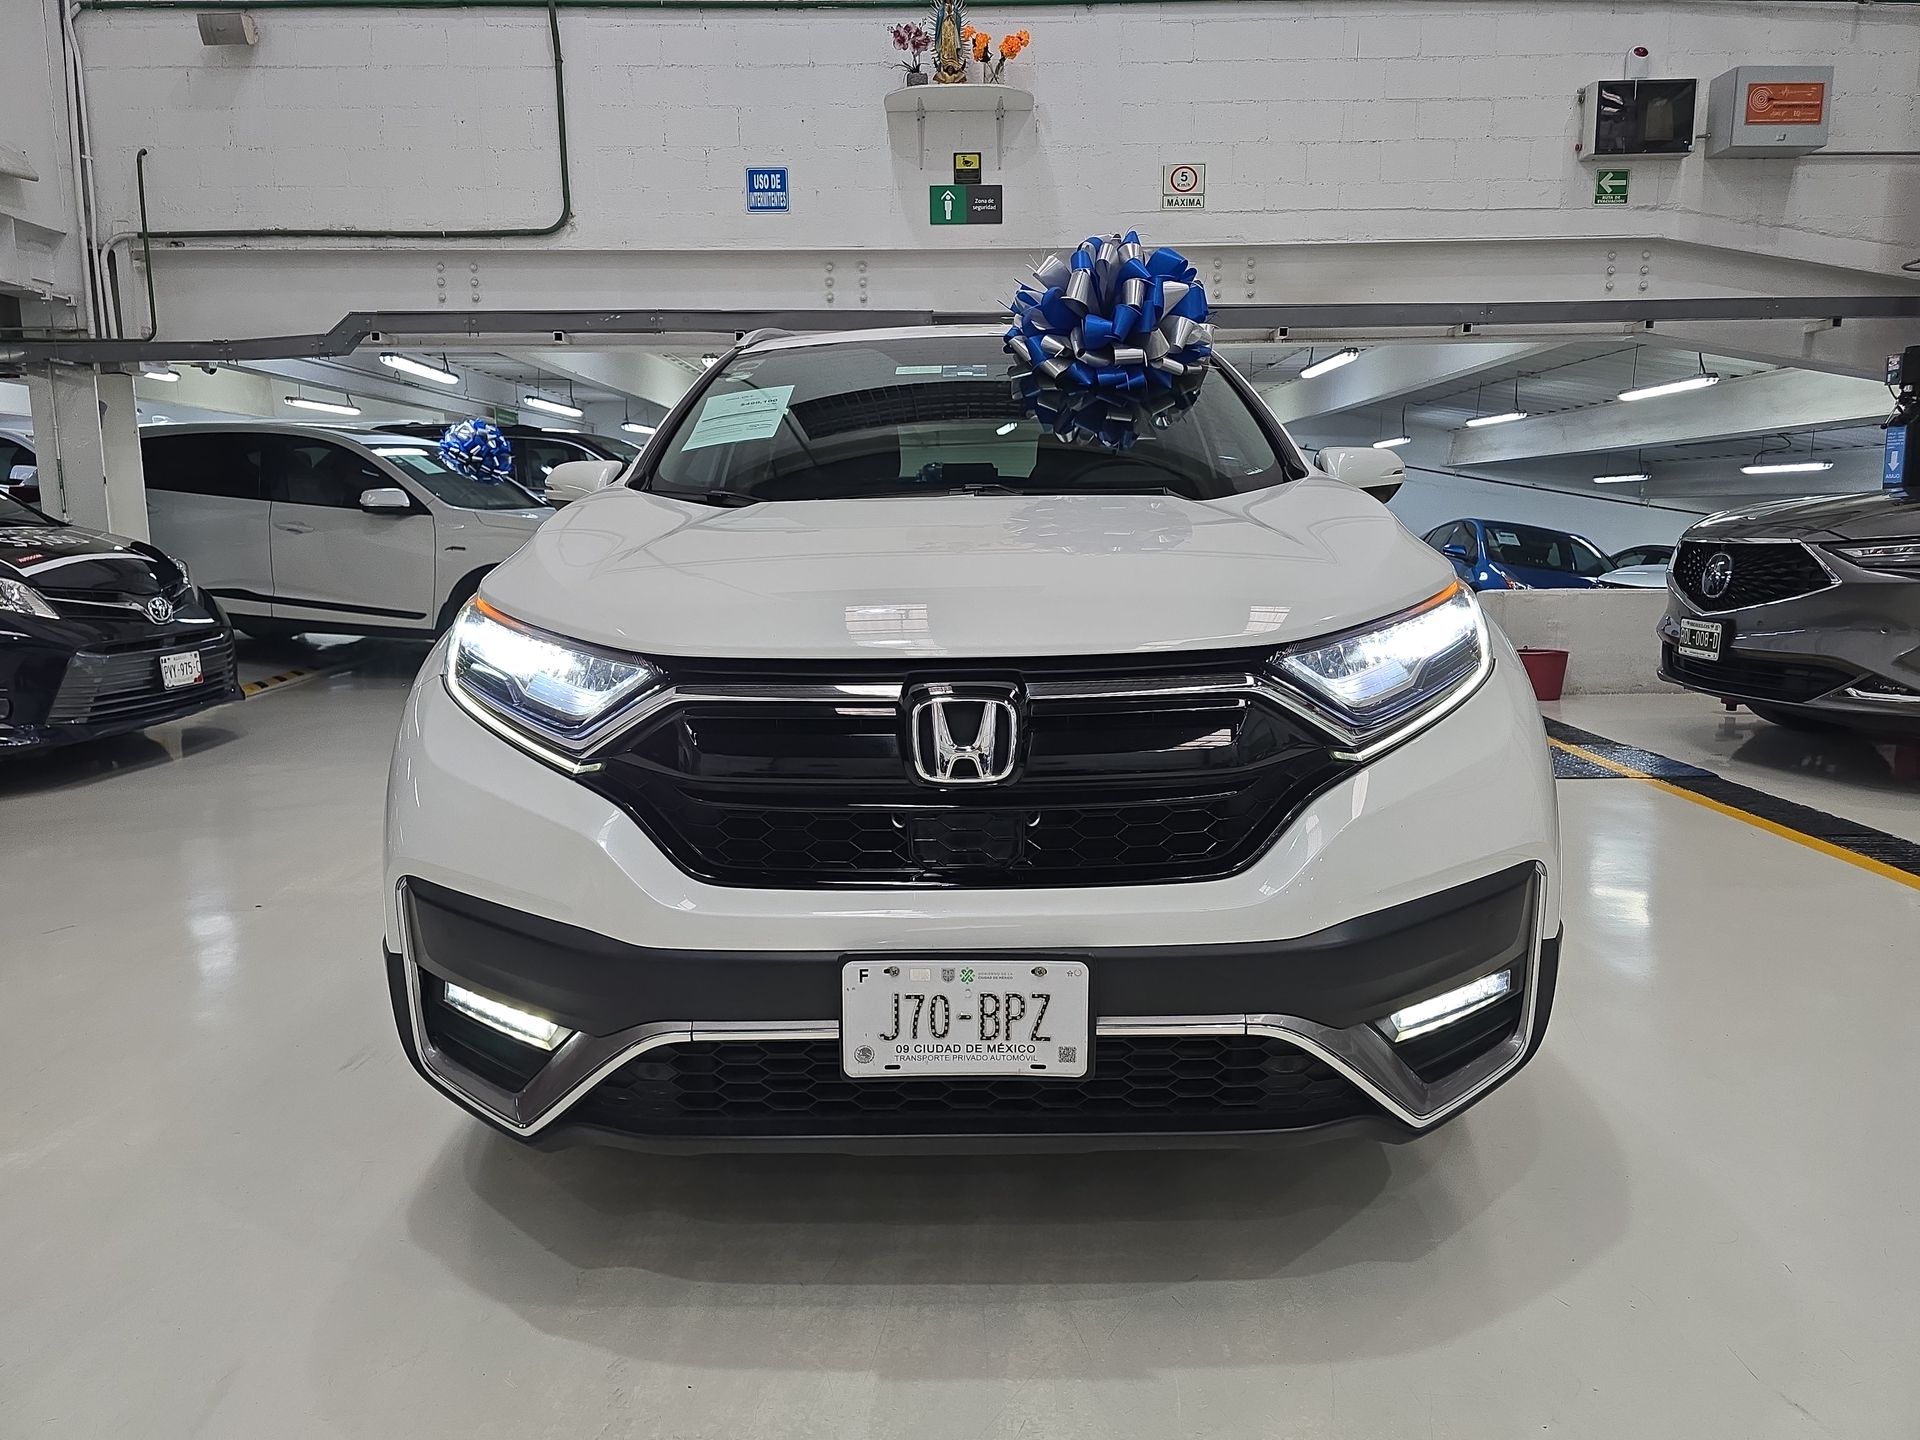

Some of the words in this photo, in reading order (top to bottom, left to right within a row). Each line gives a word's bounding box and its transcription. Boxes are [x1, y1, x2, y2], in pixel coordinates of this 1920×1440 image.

[753, 173, 769, 190] USO
[770, 173, 781, 189] DE
[1180, 171, 1188, 182] 5
[1166, 196, 1202, 207] MÁXIMA
[859, 968, 869, 983] F
[879, 992, 1052, 1042] J70-BPZ
[895, 1044, 910, 1053] 09
[913, 1044, 962, 1053] CIUDAD
[965, 1044, 982, 1053] DE
[986, 1042, 1036, 1053] MÉXICO
[894, 1054, 950, 1062] TRANSPORTE
[952, 1054, 988, 1062] PRIVADO
[989, 1053, 1038, 1062] AUTOMÓVIL
